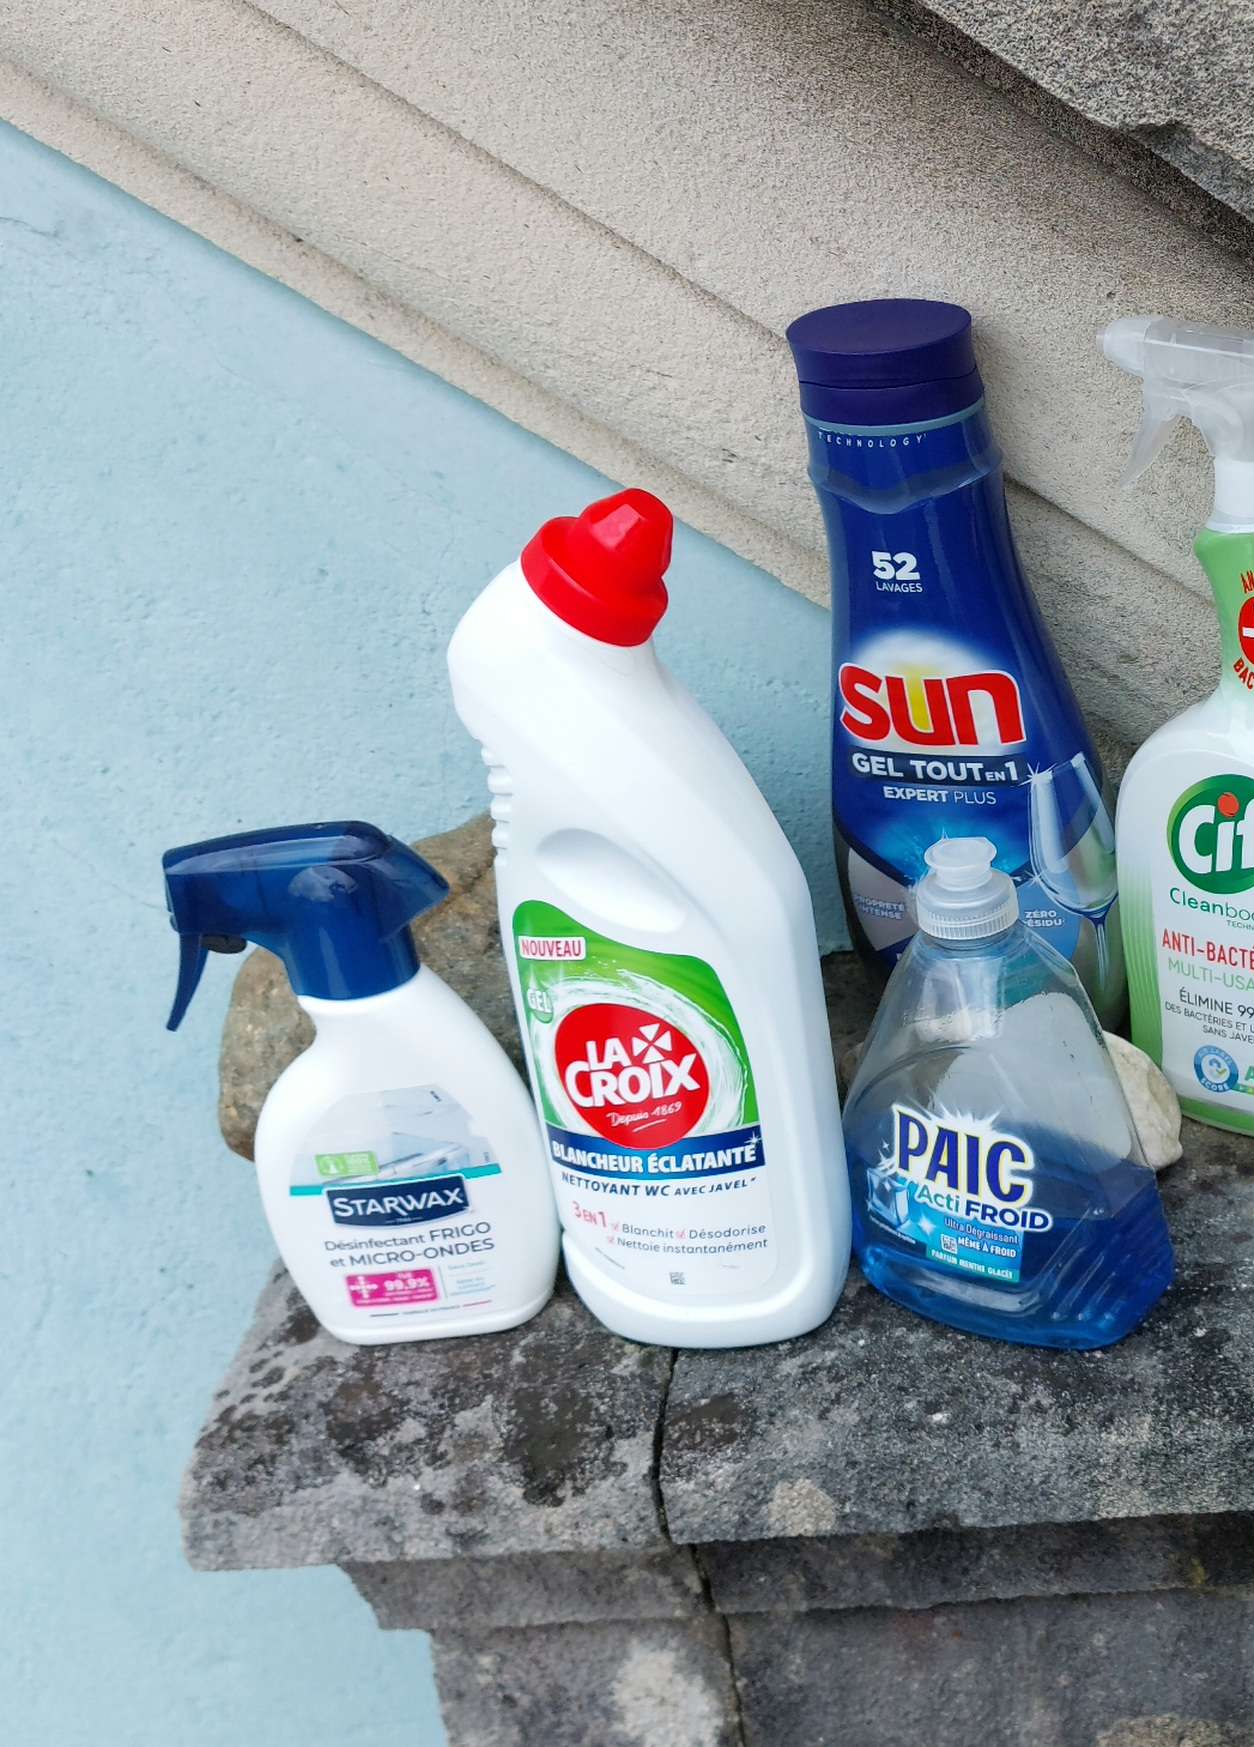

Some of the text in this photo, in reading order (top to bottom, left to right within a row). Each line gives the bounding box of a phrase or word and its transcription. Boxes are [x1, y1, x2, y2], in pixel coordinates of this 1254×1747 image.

[871, 550, 921, 581] 52
[876, 581, 923, 593] LAVAGES
[852, 752, 1019, 782] GEL TOUT EN 1
[883, 785, 997, 805] EXPERT PLUS
[521, 939, 582, 957] NOUVEAU
[527, 988, 552, 1013] GEL
[1179, 986, 1233, 1016] ÉLIMINE
[1165, 1001, 1182, 1014] DES
[1184, 1008, 1233, 1028] BACTÉRIES
[1235, 1021, 1248, 1032] ET
[1202, 1025, 1228, 1039] SANS
[585, 1039, 630, 1071] LA
[565, 1053, 701, 1108] CROIX
[606, 1101, 682, 1127] Depuis 1869
[551, 1140, 756, 1174] BLANCHEUR ÉCLATANTE
[896, 1110, 1026, 1203] PAIC
[561, 1171, 748, 1197] NETTOYANT WC AVEC JAVEL
[333, 1187, 464, 1217] STARWAX
[572, 1200, 607, 1228] 3 EN 1
[917, 1184, 1050, 1229] Acti FROID
[324, 1221, 491, 1252] Désinfectant FRIGO
[617, 1237, 768, 1254] Nettoie instantanément
[622, 1223, 766, 1240] Blanchit Désodorise
[966, 1225, 1019, 1244] Dégraissant
[330, 1256, 345, 1268] et
[349, 1237, 495, 1267] MICRO-ONDES
[958, 1235, 981, 1251] MÊME
[990, 1243, 1017, 1258] FROID
